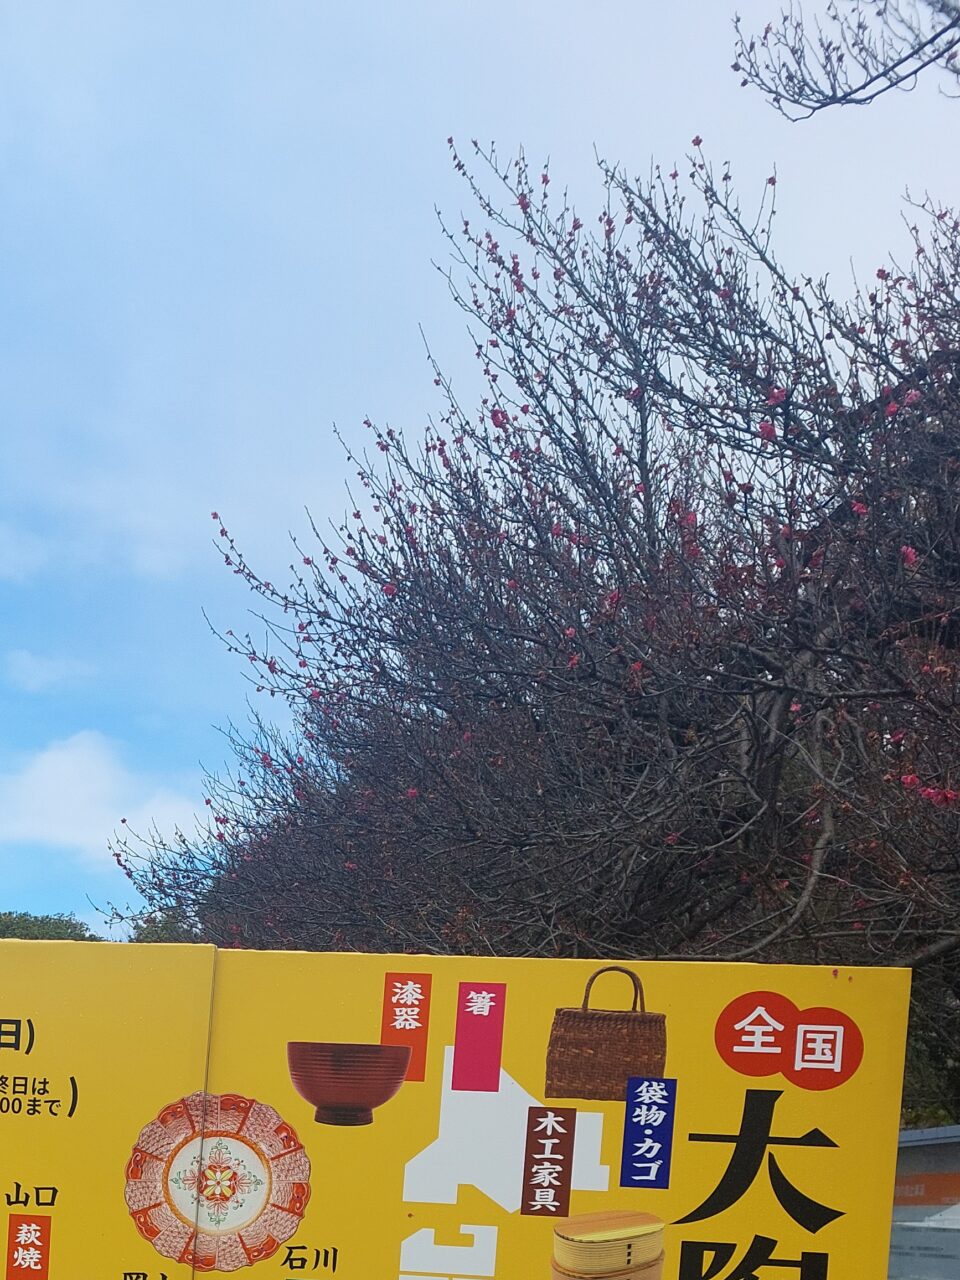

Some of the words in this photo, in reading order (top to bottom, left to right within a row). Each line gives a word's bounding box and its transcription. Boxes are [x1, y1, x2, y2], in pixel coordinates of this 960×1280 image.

[390, 980, 425, 1030] 漆器
[465, 990, 496, 1017] 箸
[732, 1006, 845, 1073] 全国
[529, 1111, 568, 1212] 木工家具
[4, 1181, 59, 1207] 山口
[13, 1223, 43, 1270] 萩焼
[280, 1246, 339, 1273] 石川
